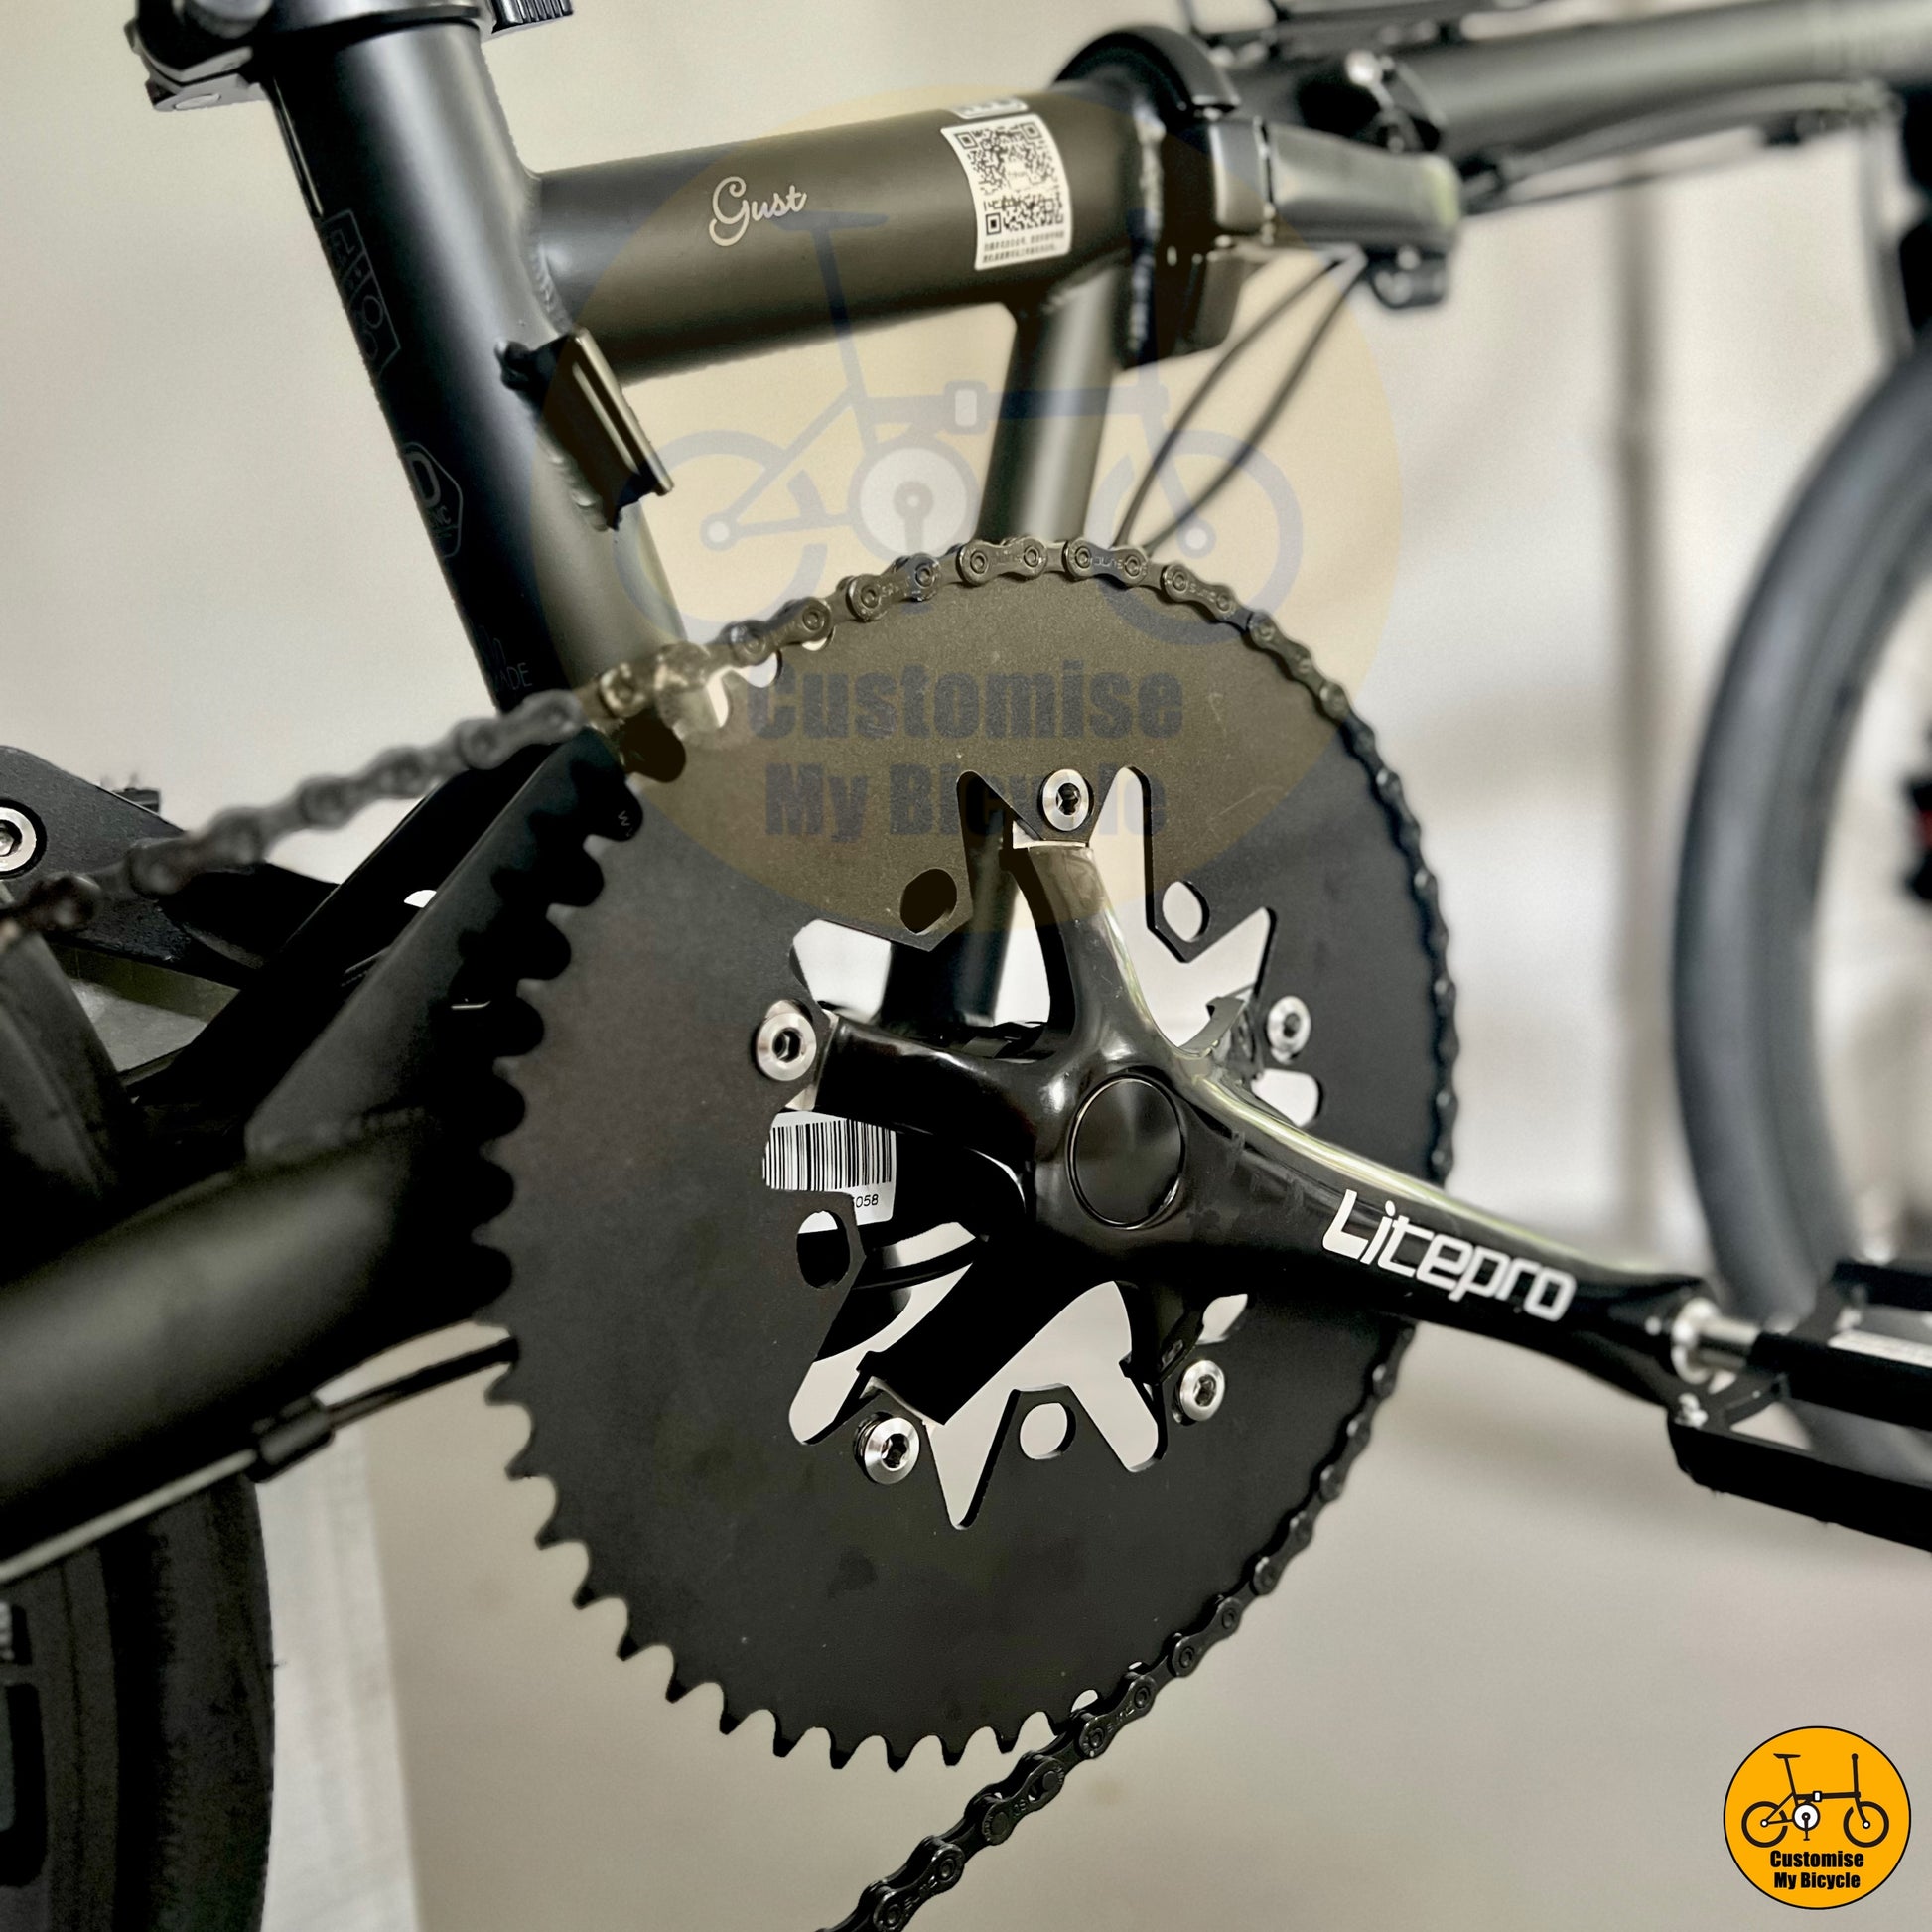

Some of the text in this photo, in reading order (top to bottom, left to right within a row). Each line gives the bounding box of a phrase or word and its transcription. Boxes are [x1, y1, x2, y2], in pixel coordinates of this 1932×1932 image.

[709, 177, 807, 246] Gust
[853, 1194, 879, 1208] 058
[1322, 1189, 1577, 1321] Litepro
